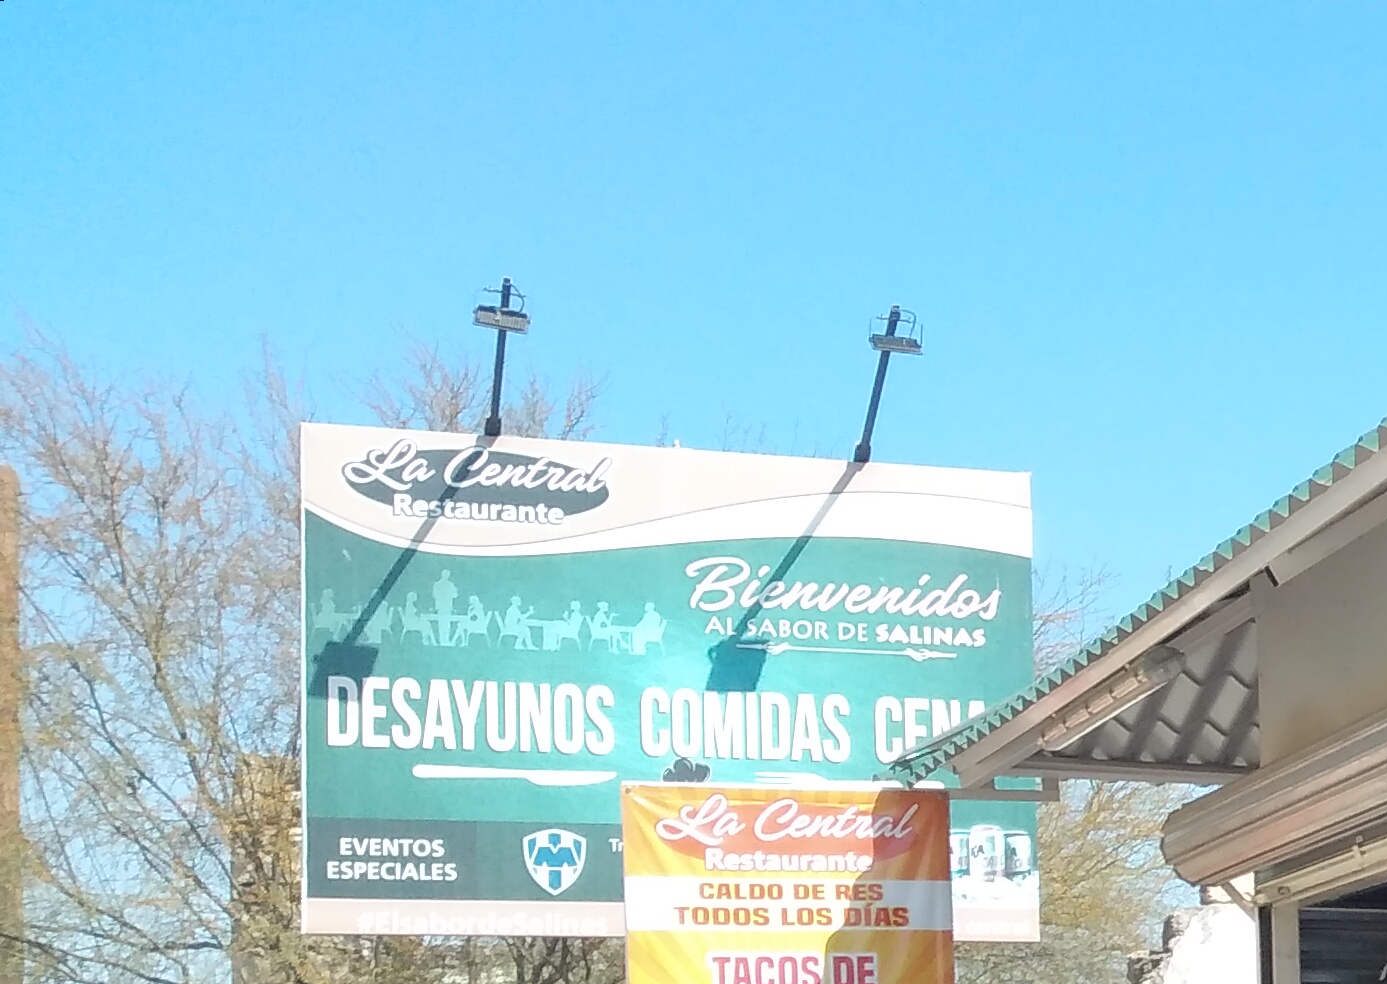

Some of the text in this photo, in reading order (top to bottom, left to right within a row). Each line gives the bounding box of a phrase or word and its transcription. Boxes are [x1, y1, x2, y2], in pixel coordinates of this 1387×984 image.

[344, 440, 612, 494] La Central
[394, 493, 566, 525] Restaurante
[685, 556, 1002, 621] Bienvenidos
[704, 617, 986, 648] AL SABOR DE SALINAS
[326, 676, 986, 764] DESAYUNOS COMIDAS CEN
[656, 794, 919, 845] La Central
[339, 837, 445, 859] EVENTOS
[704, 846, 873, 875] Restaurante
[327, 860, 458, 883] ESPECIALES
[698, 881, 884, 902] CALDO DE RES
[674, 901, 910, 928] TODOS LOS DÍAS
